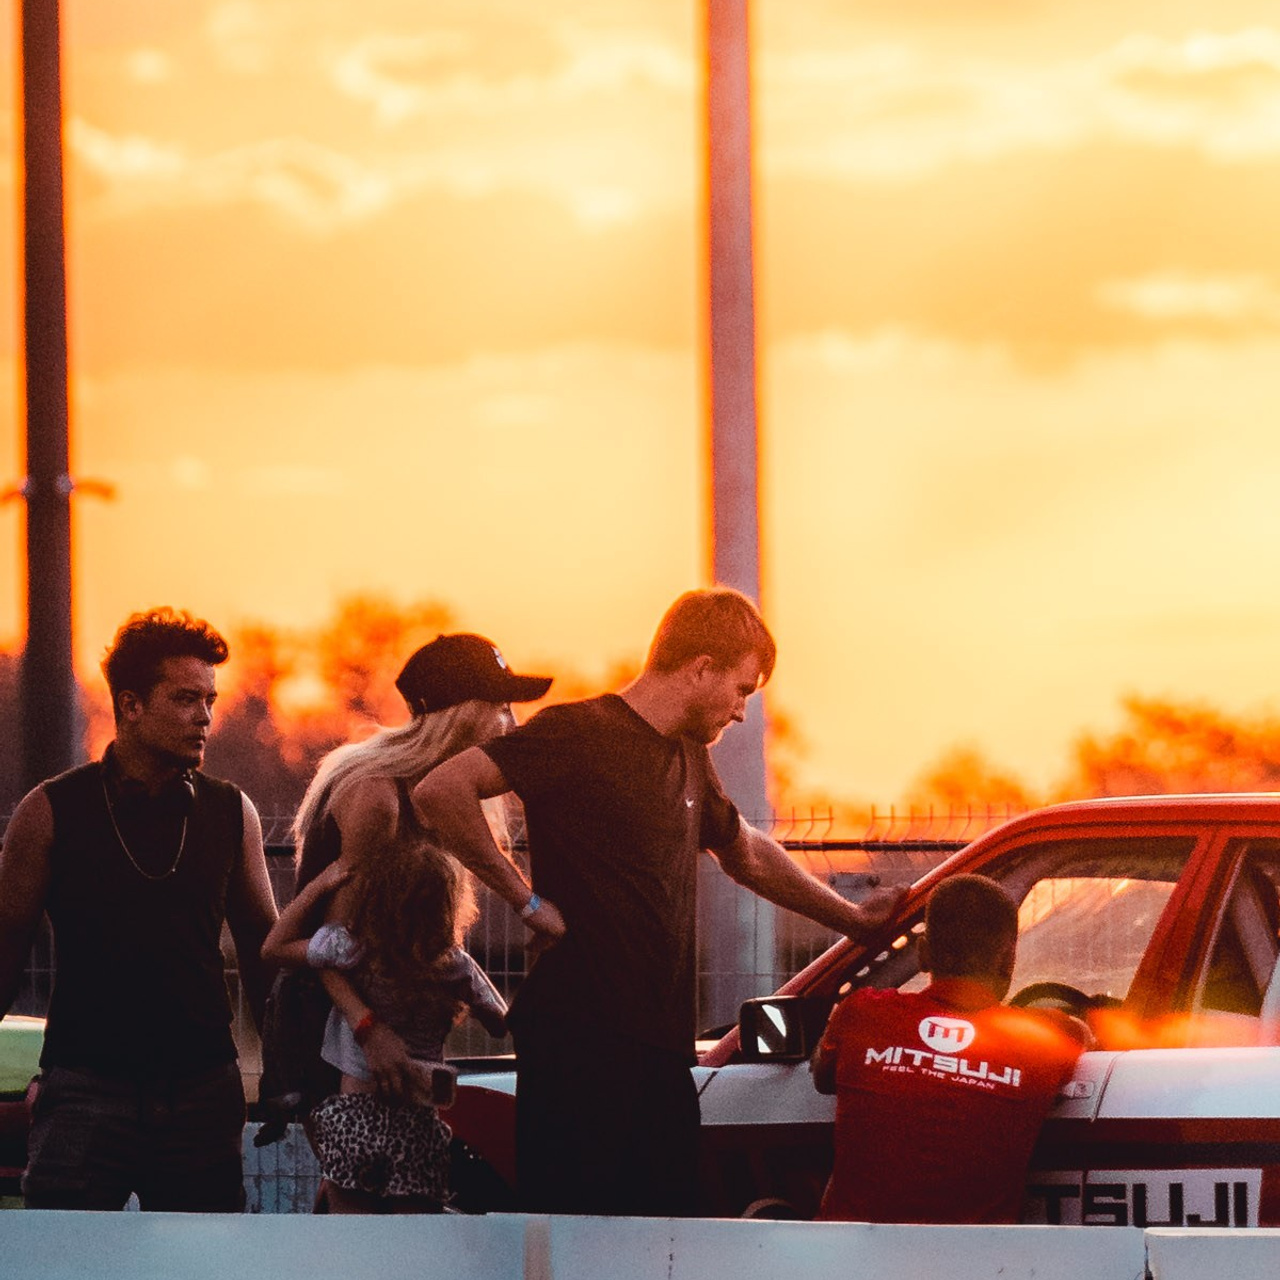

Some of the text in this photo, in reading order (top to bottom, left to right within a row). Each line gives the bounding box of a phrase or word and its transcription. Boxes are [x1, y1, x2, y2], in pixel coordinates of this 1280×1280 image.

[864, 1046, 1021, 1087] MITSUJI
[882, 1065, 996, 1090] FEEL THE JAPAN
